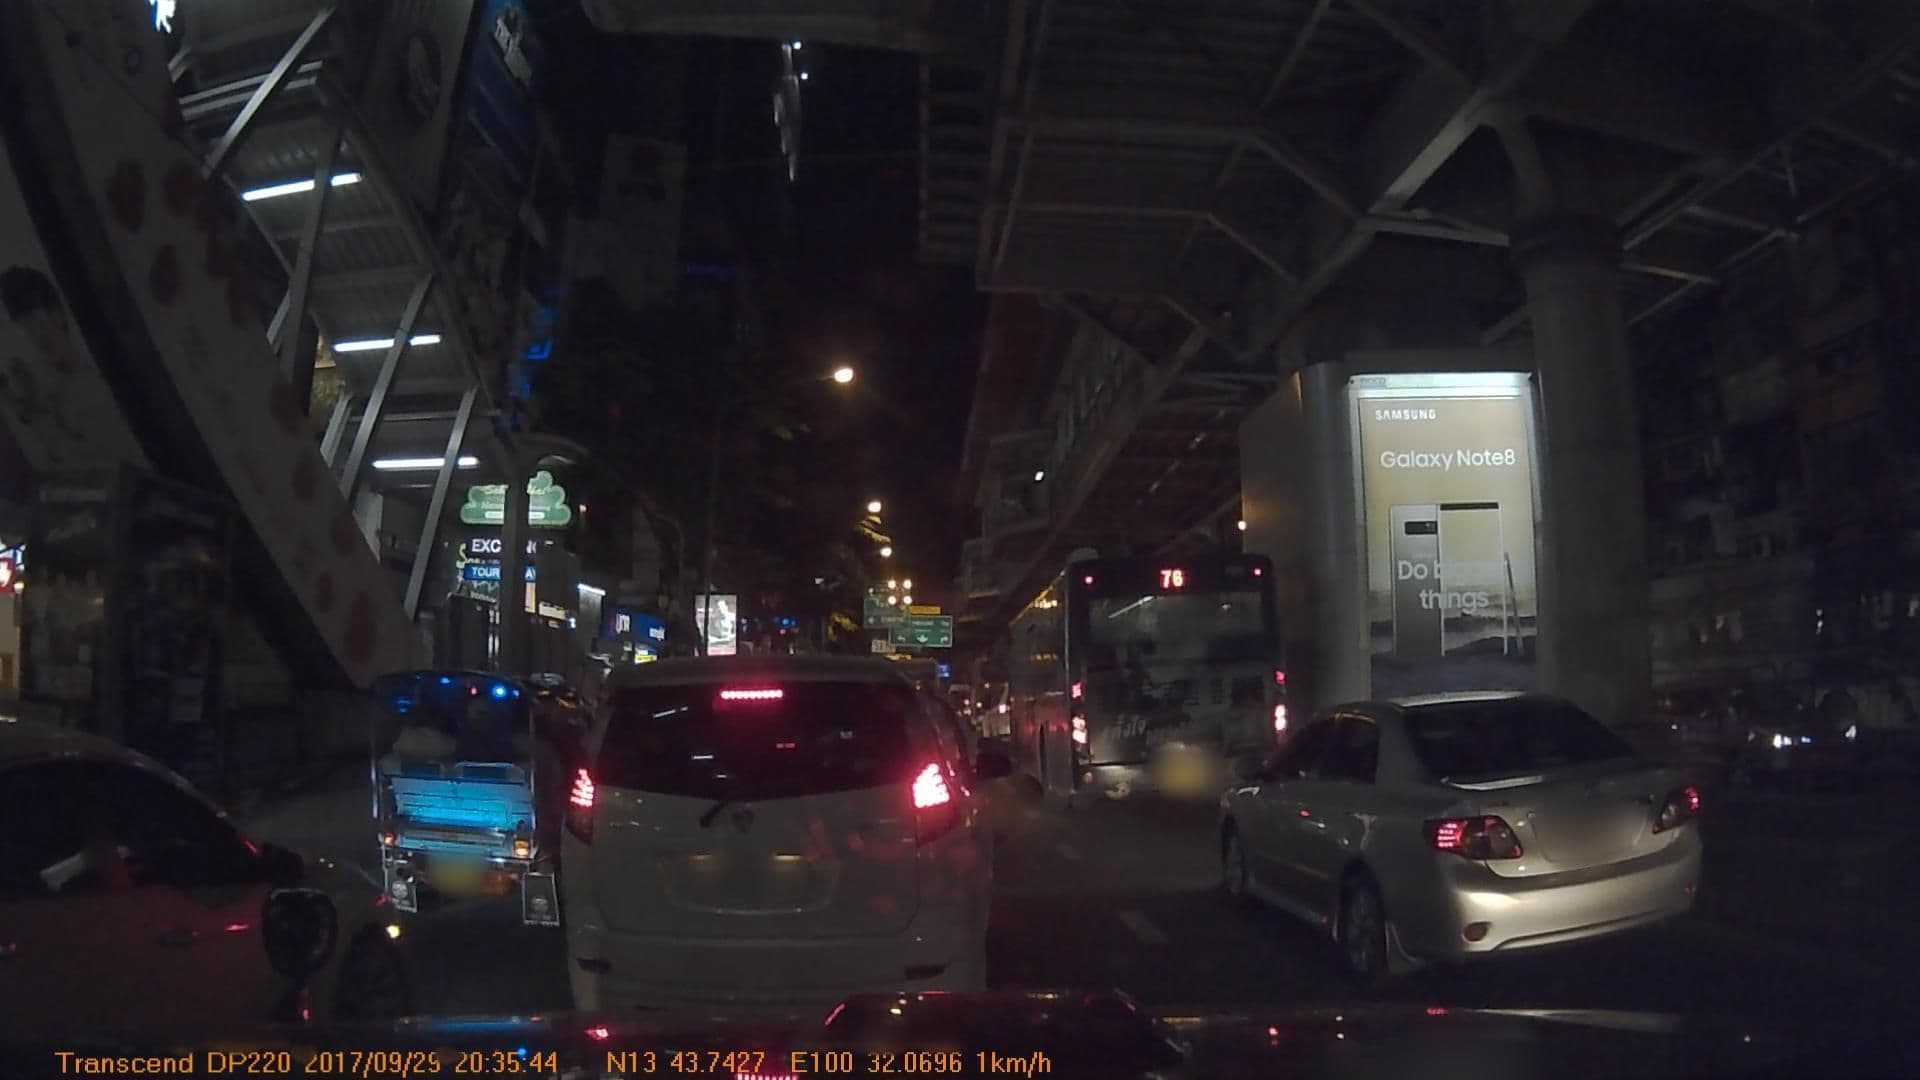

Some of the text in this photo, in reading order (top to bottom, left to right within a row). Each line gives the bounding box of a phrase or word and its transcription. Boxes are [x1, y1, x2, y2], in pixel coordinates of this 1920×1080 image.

[1375, 408, 1436, 422] SAMSUNG
[1380, 447, 1516, 473] Galaxy Note8
[1160, 569, 1184, 589] 76
[1398, 559, 1428, 581] Do
